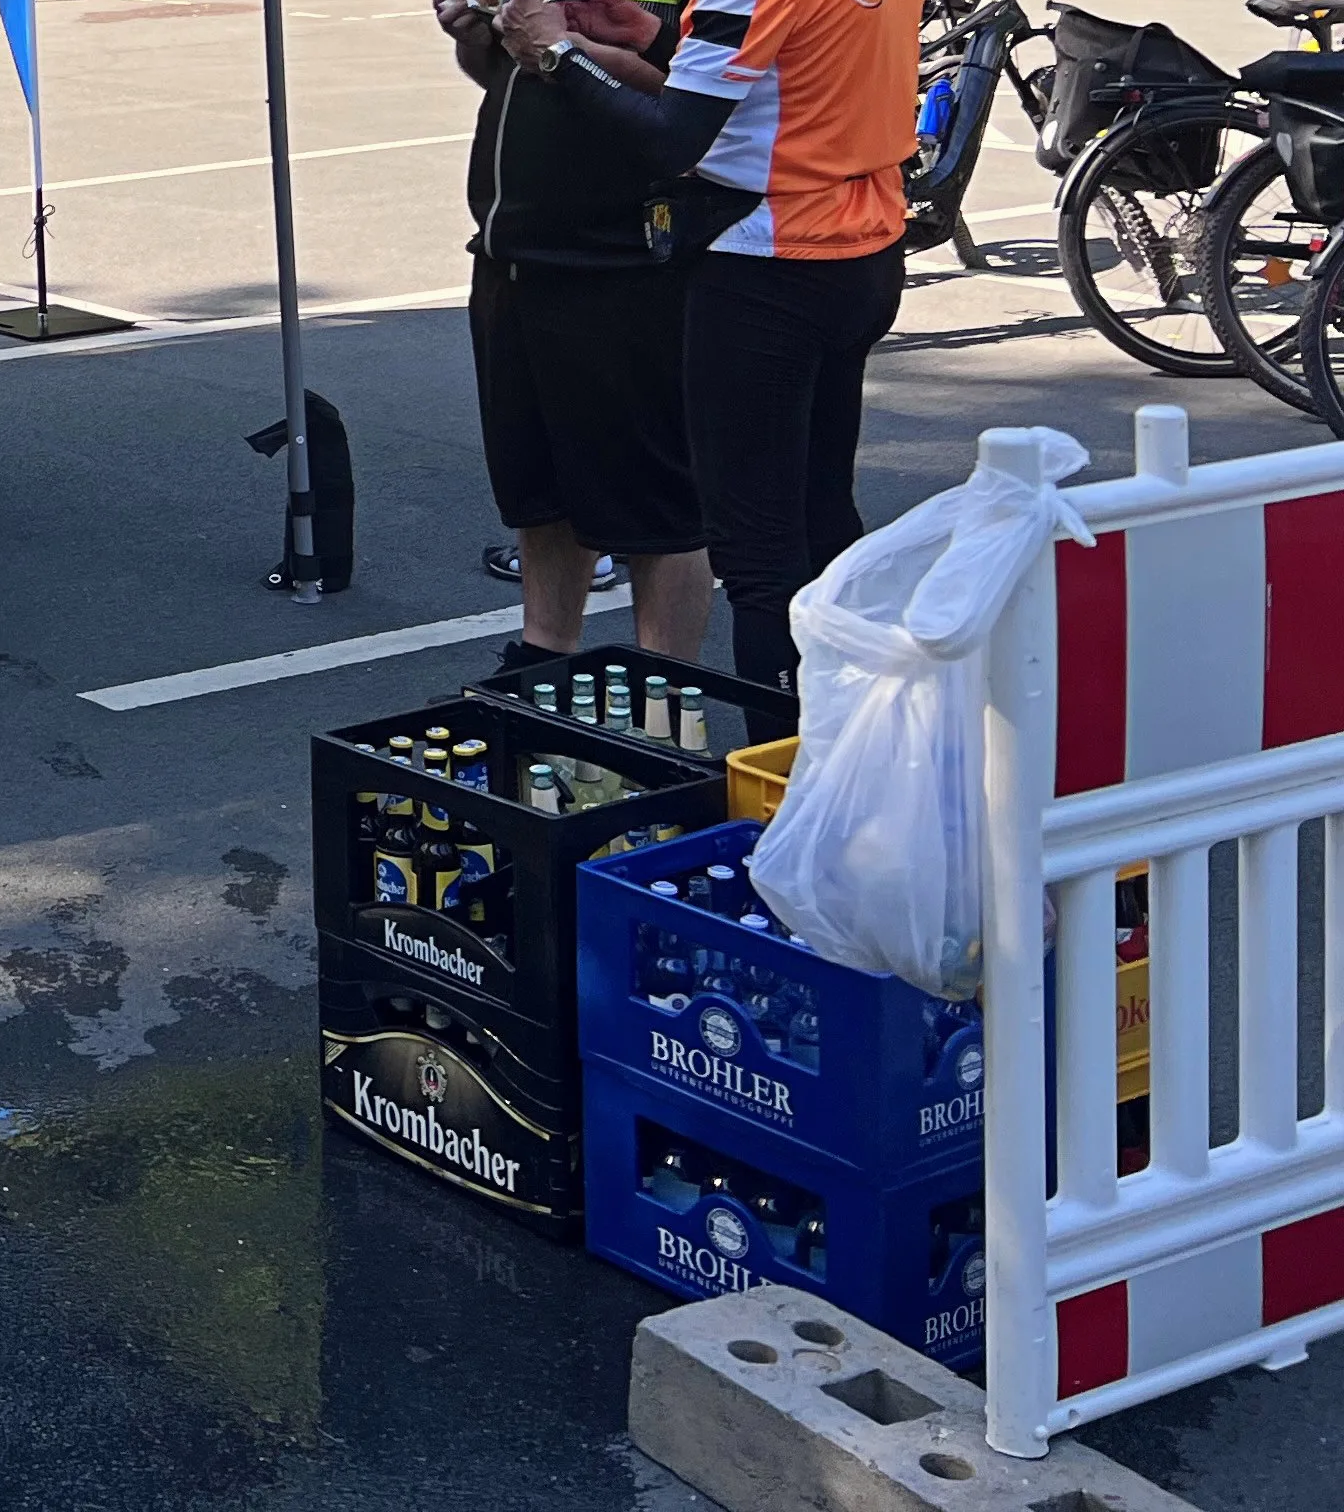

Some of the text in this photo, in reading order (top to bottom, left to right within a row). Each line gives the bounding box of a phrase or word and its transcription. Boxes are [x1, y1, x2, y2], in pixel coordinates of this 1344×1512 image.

[384, 918, 485, 986] Krombacher
[650, 1030, 793, 1116] BROHLER
[353, 1070, 520, 1193] Krombacher
